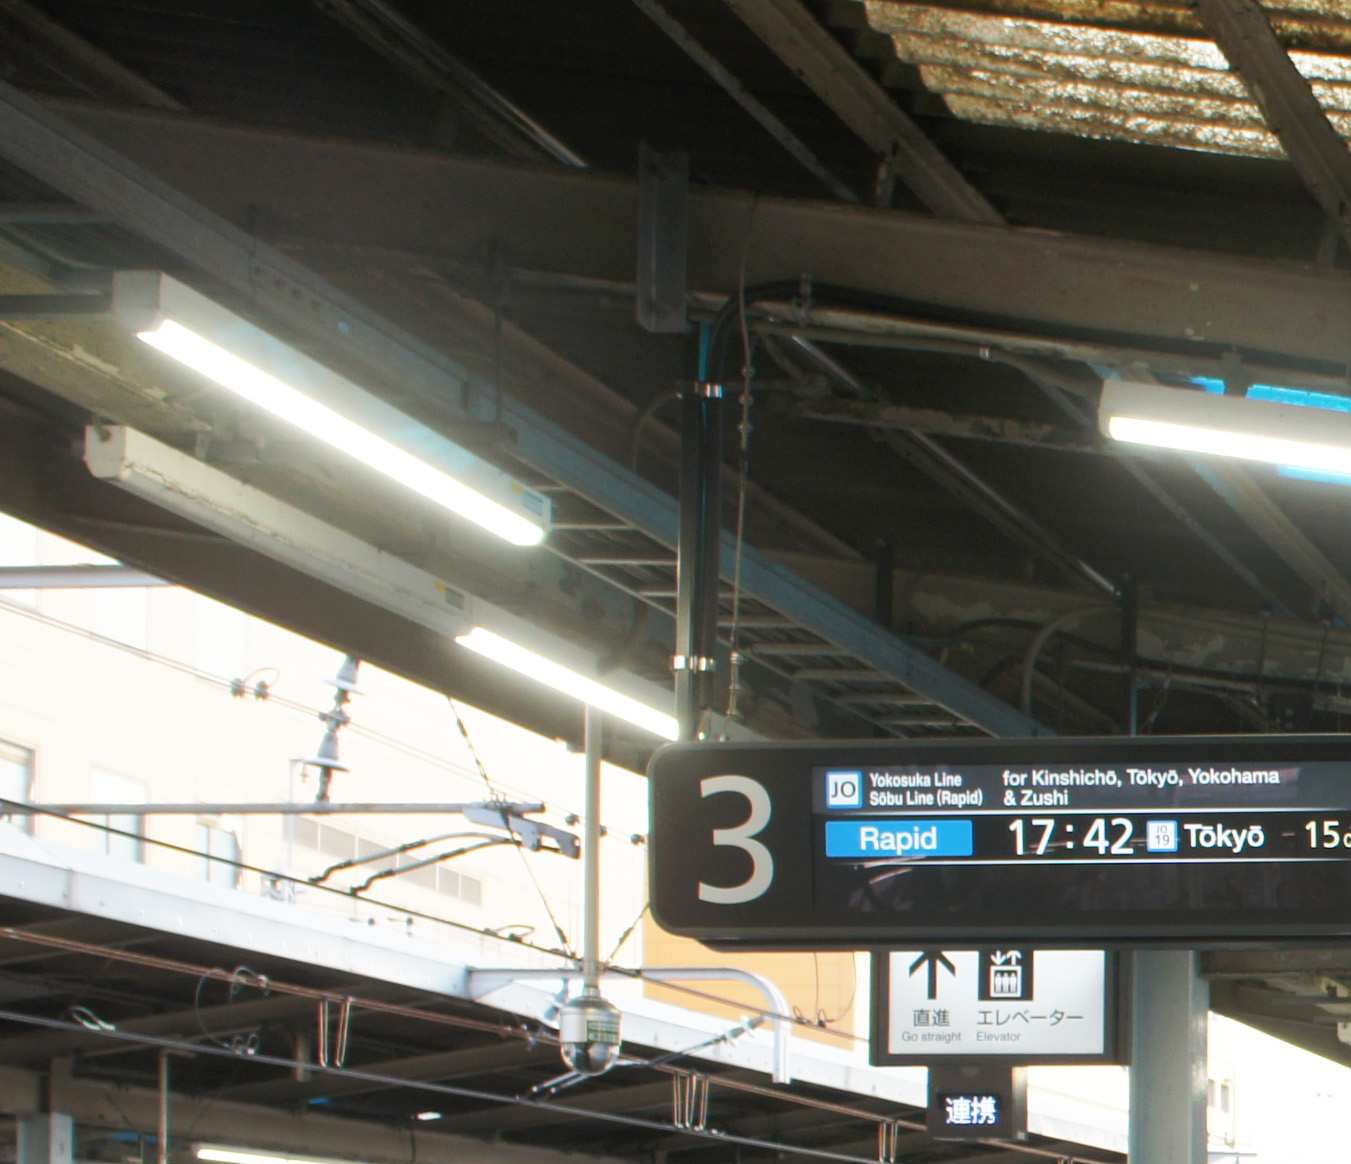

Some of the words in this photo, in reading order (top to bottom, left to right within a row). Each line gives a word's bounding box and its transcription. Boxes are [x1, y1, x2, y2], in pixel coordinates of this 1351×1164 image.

[869, 772, 932, 788] Yokosuka
[934, 772, 963, 791] Line
[1002, 769, 1028, 787] for
[1031, 769, 1122, 788] Kinshichō,
[1126, 768, 1184, 789] Tōkyō,
[1187, 767, 1281, 785] Yokohama
[829, 779, 858, 800] JO
[869, 790, 904, 806] Sōbu
[905, 790, 935, 806] Line
[936, 789, 983, 809] (Rapid)
[1003, 789, 1017, 807] &
[1020, 789, 1069, 806] Zushi
[698, 774, 774, 904] 3
[1009, 817, 1134, 856] 17:42
[1156, 824, 1168, 834] JO
[1183, 823, 1265, 853] Tōkyō
[1305, 820, 1340, 849] 15
[860, 826, 937, 856] Rapid
[1155, 834, 1170, 846] 19
[913, 1008, 950, 1027] 直進
[977, 1009, 1084, 1027] エレベーター
[901, 1030, 919, 1042] Go
[921, 1031, 962, 1045] straight
[976, 1031, 1021, 1042] Elevator
[945, 1096, 997, 1125] 連携
